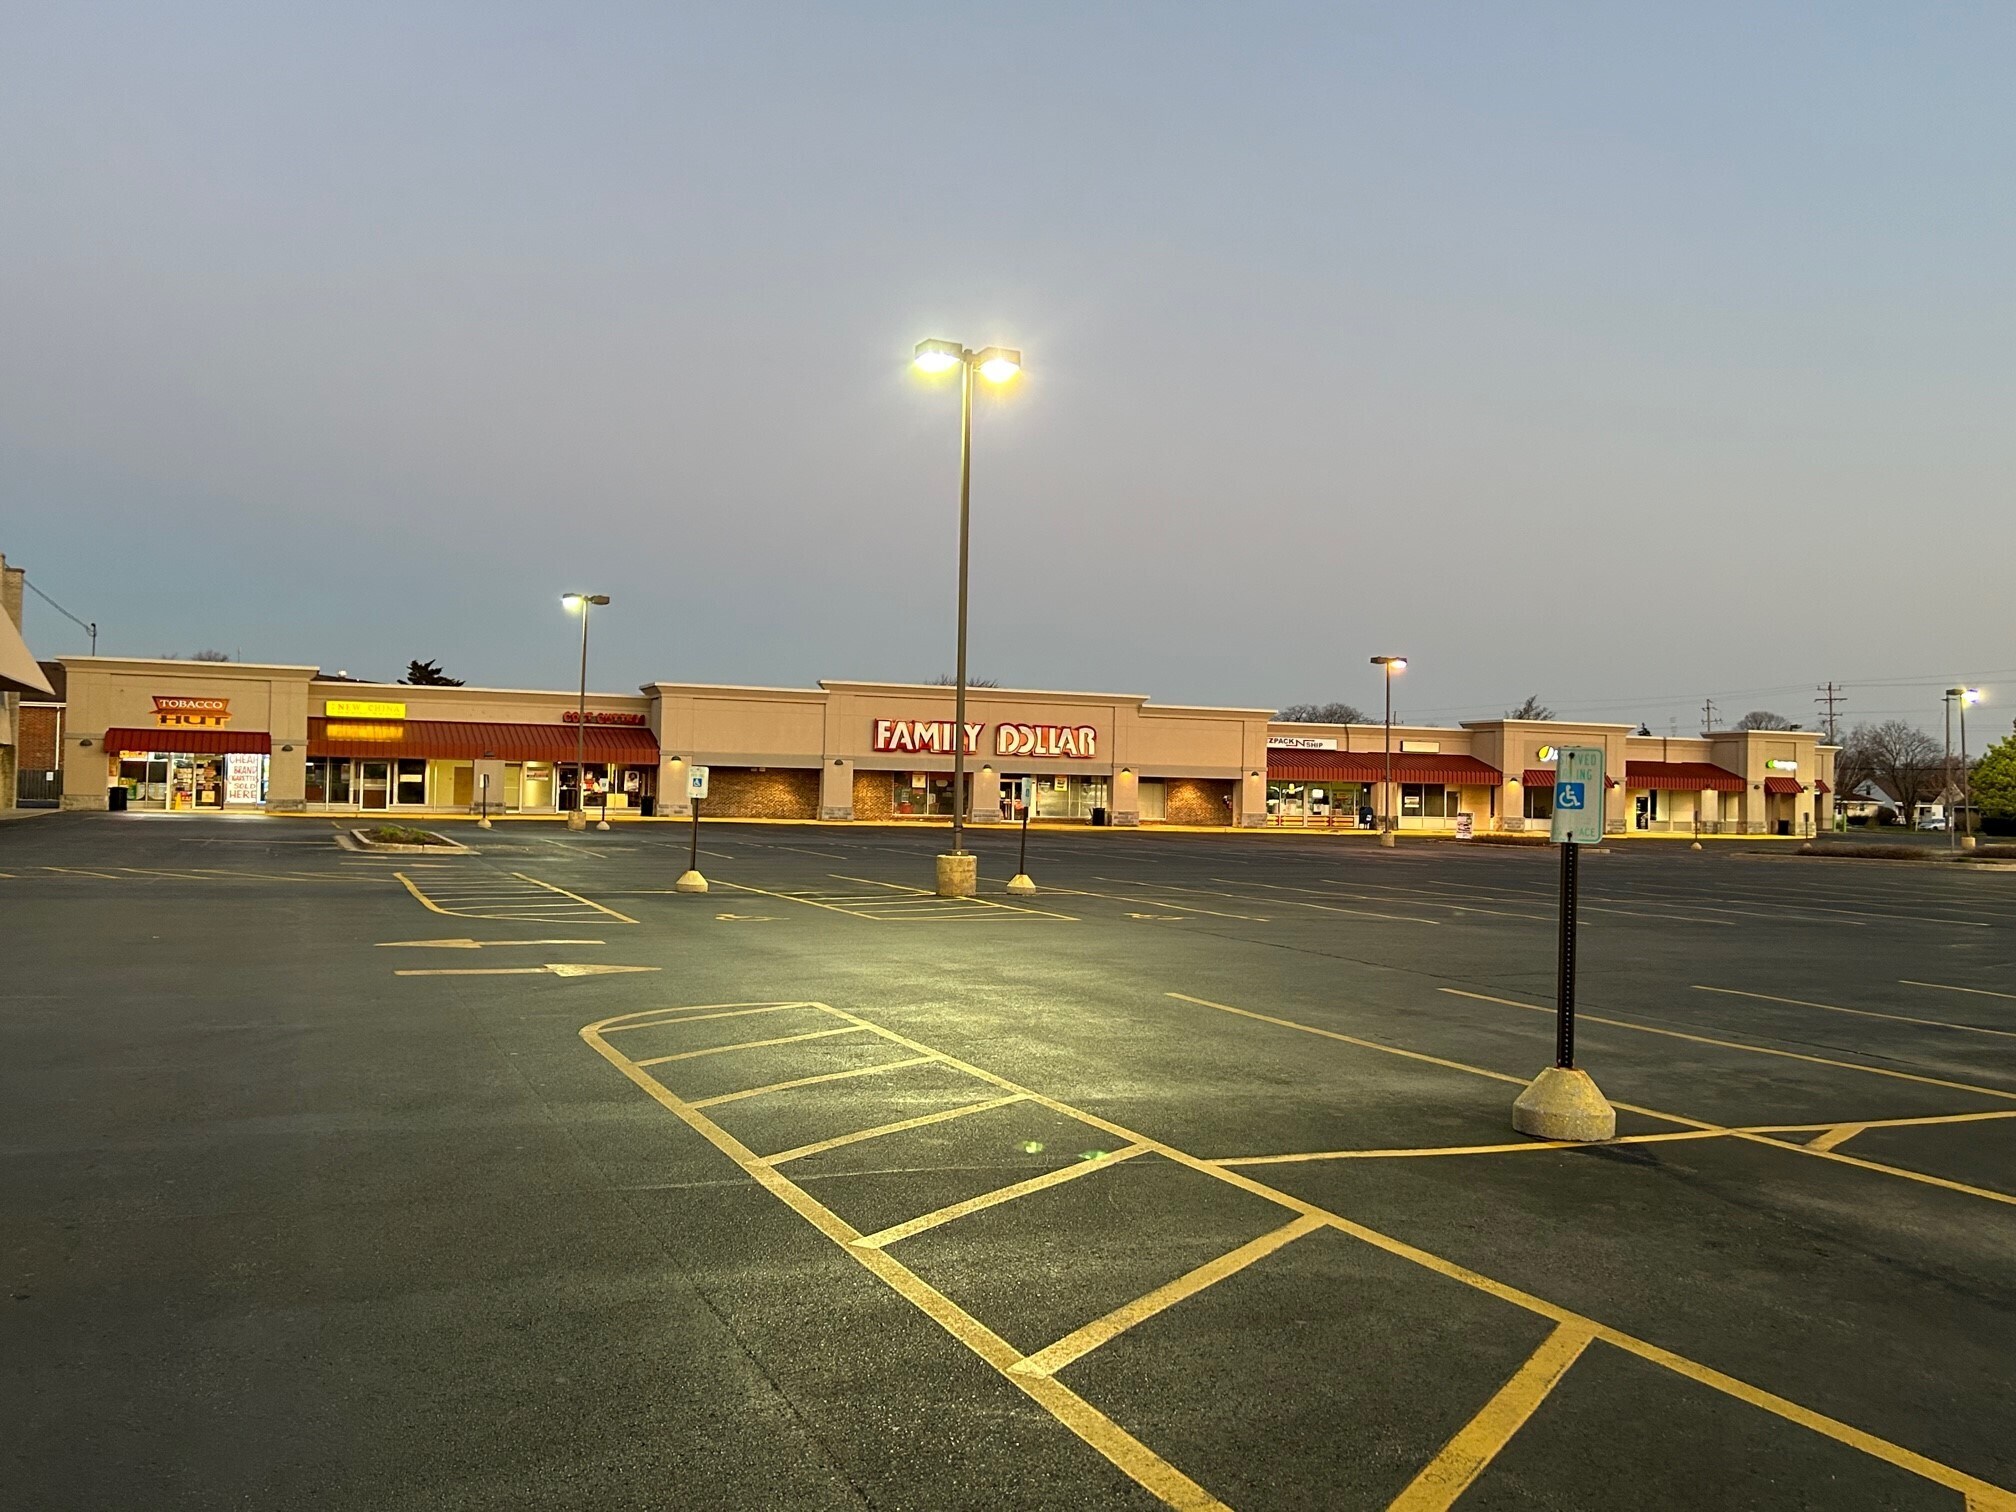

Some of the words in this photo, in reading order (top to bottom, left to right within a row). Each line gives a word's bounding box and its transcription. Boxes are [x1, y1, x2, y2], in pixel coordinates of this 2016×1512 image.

[159, 699, 223, 709] TOBACCO
[368, 704, 400, 712] CHINA
[159, 715, 226, 726] HUT
[563, 711, 594, 723] COT
[996, 723, 1097, 758] DOLLAR
[229, 790, 257, 799] HERE
